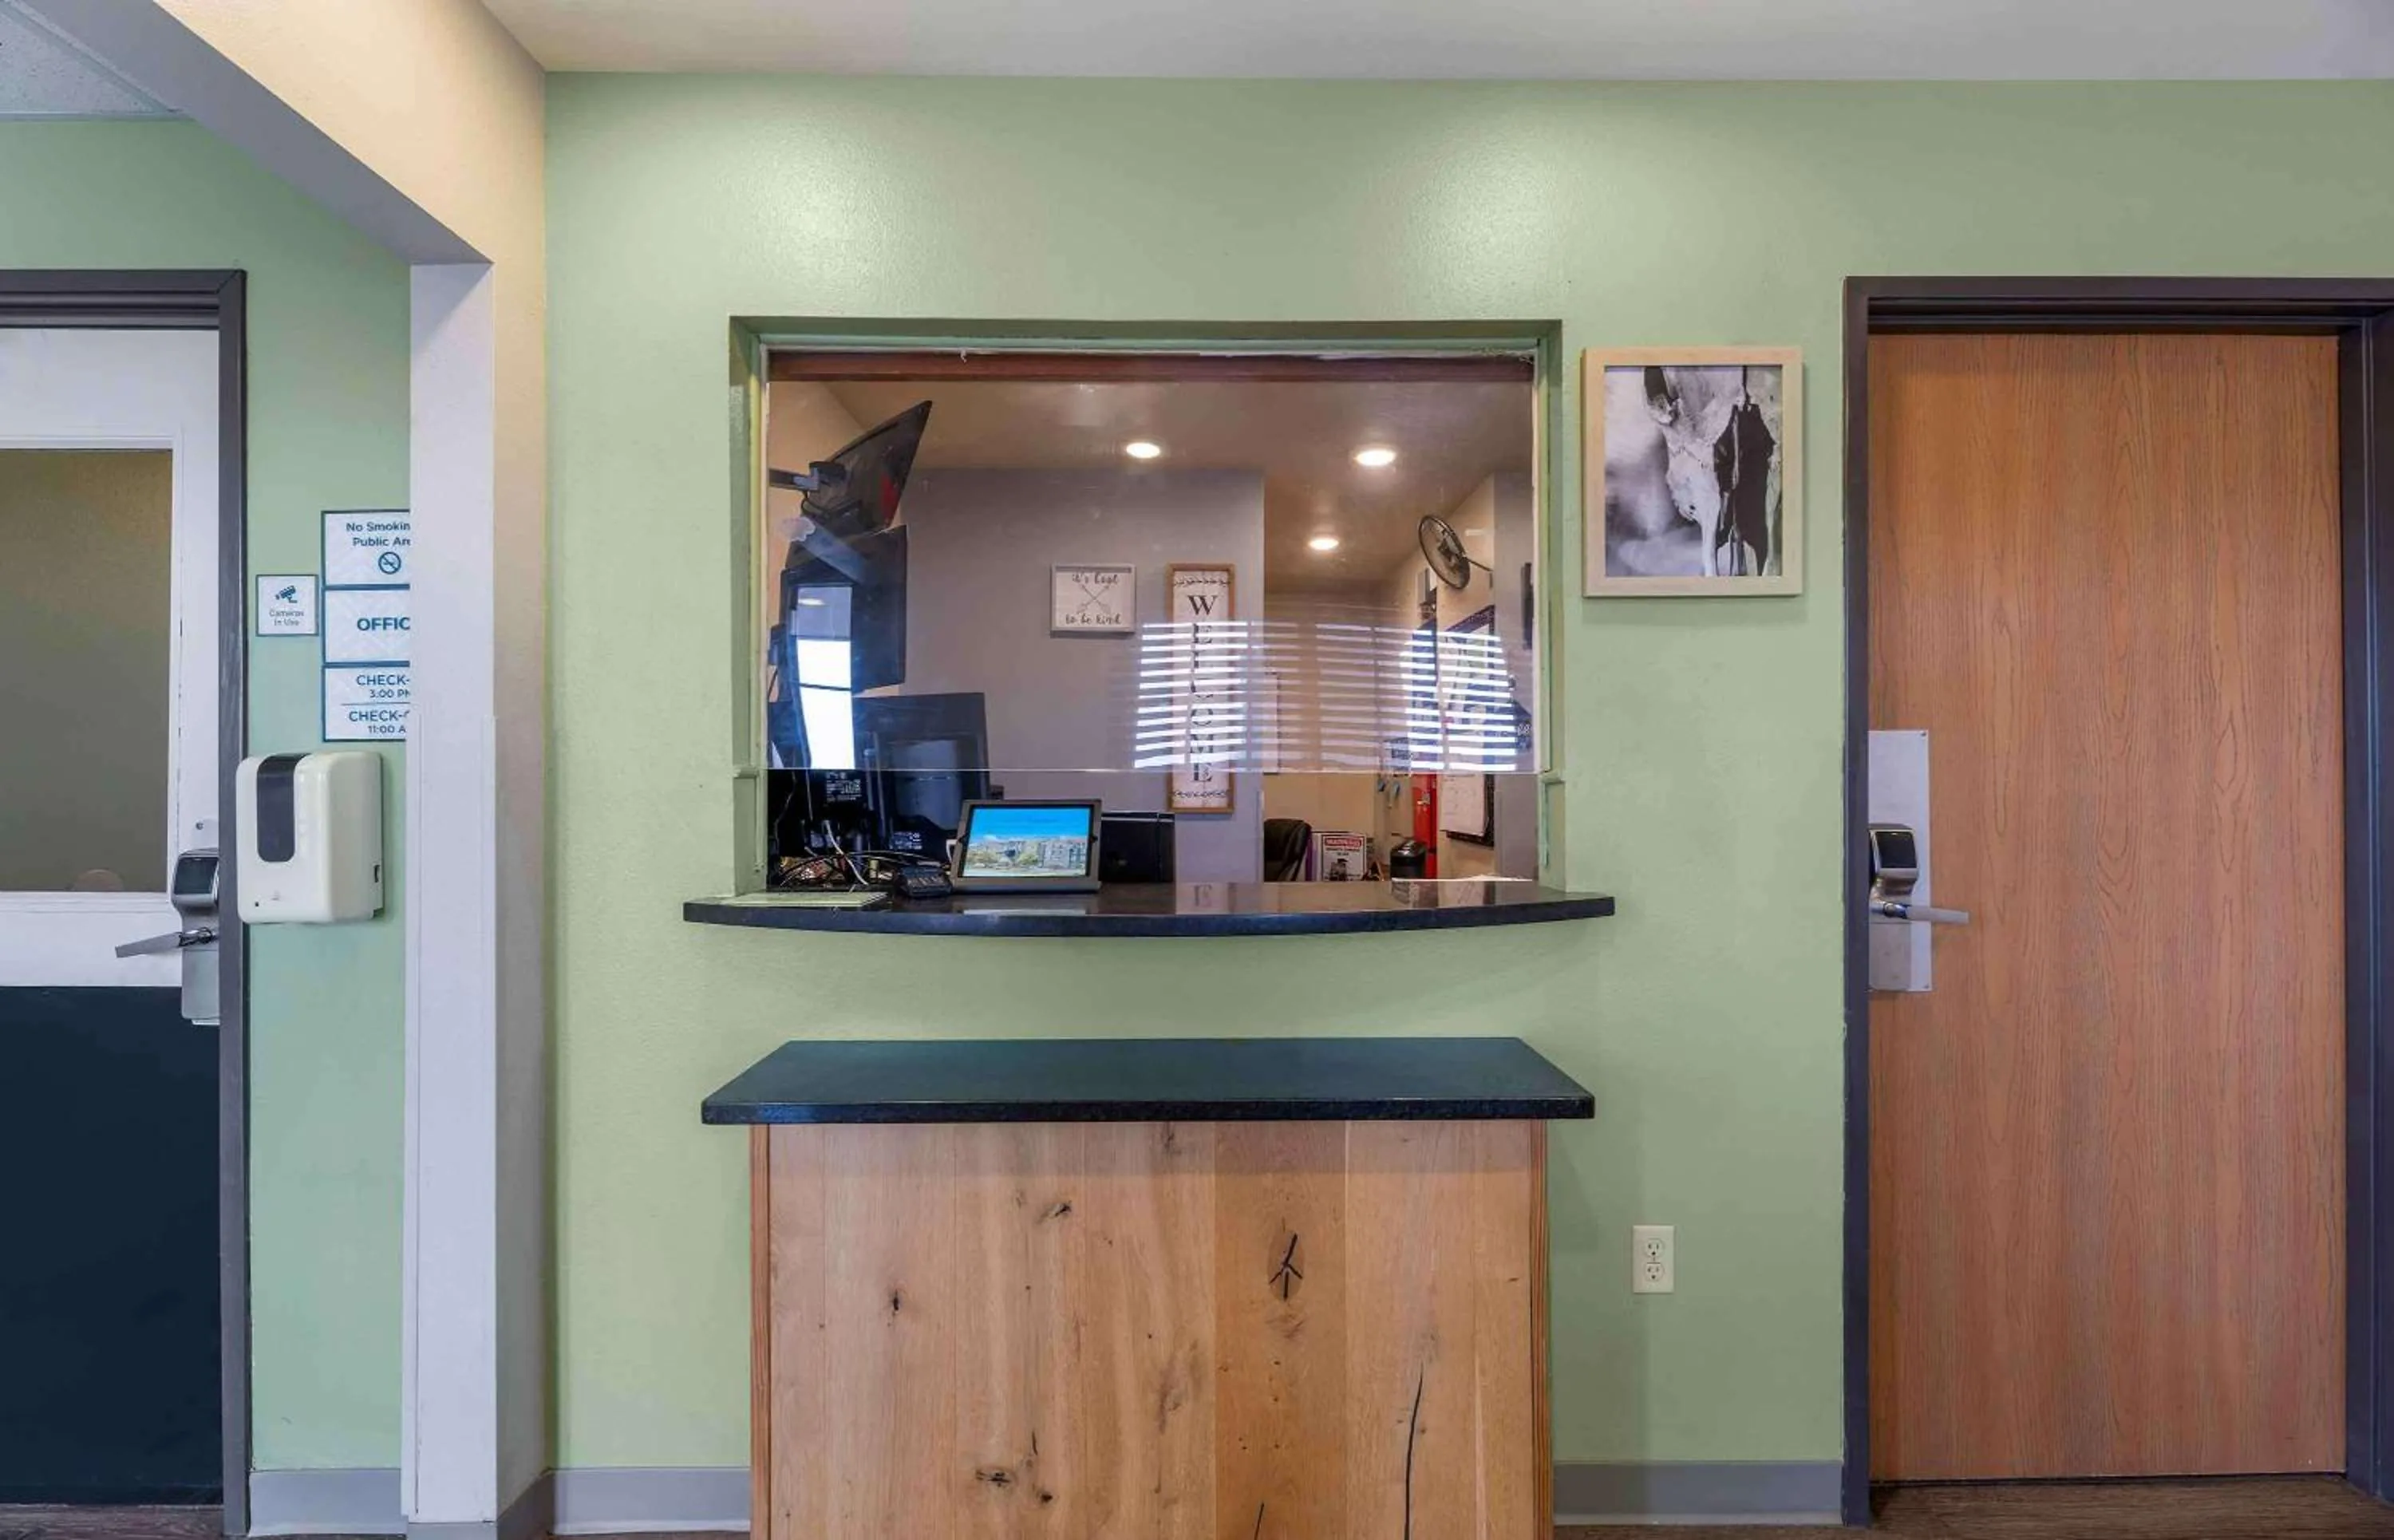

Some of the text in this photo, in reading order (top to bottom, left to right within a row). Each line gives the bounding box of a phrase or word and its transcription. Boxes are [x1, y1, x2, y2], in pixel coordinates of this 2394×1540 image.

[346, 522, 411, 531] No Smokin
[353, 536, 389, 547] Public
[358, 617, 411, 630] OFFIC
[356, 674, 410, 685] CHECK-
[369, 689, 395, 698] 3:00
[1187, 595, 1218, 782] WELCOME
[368, 725, 406, 734] 11:00 A
